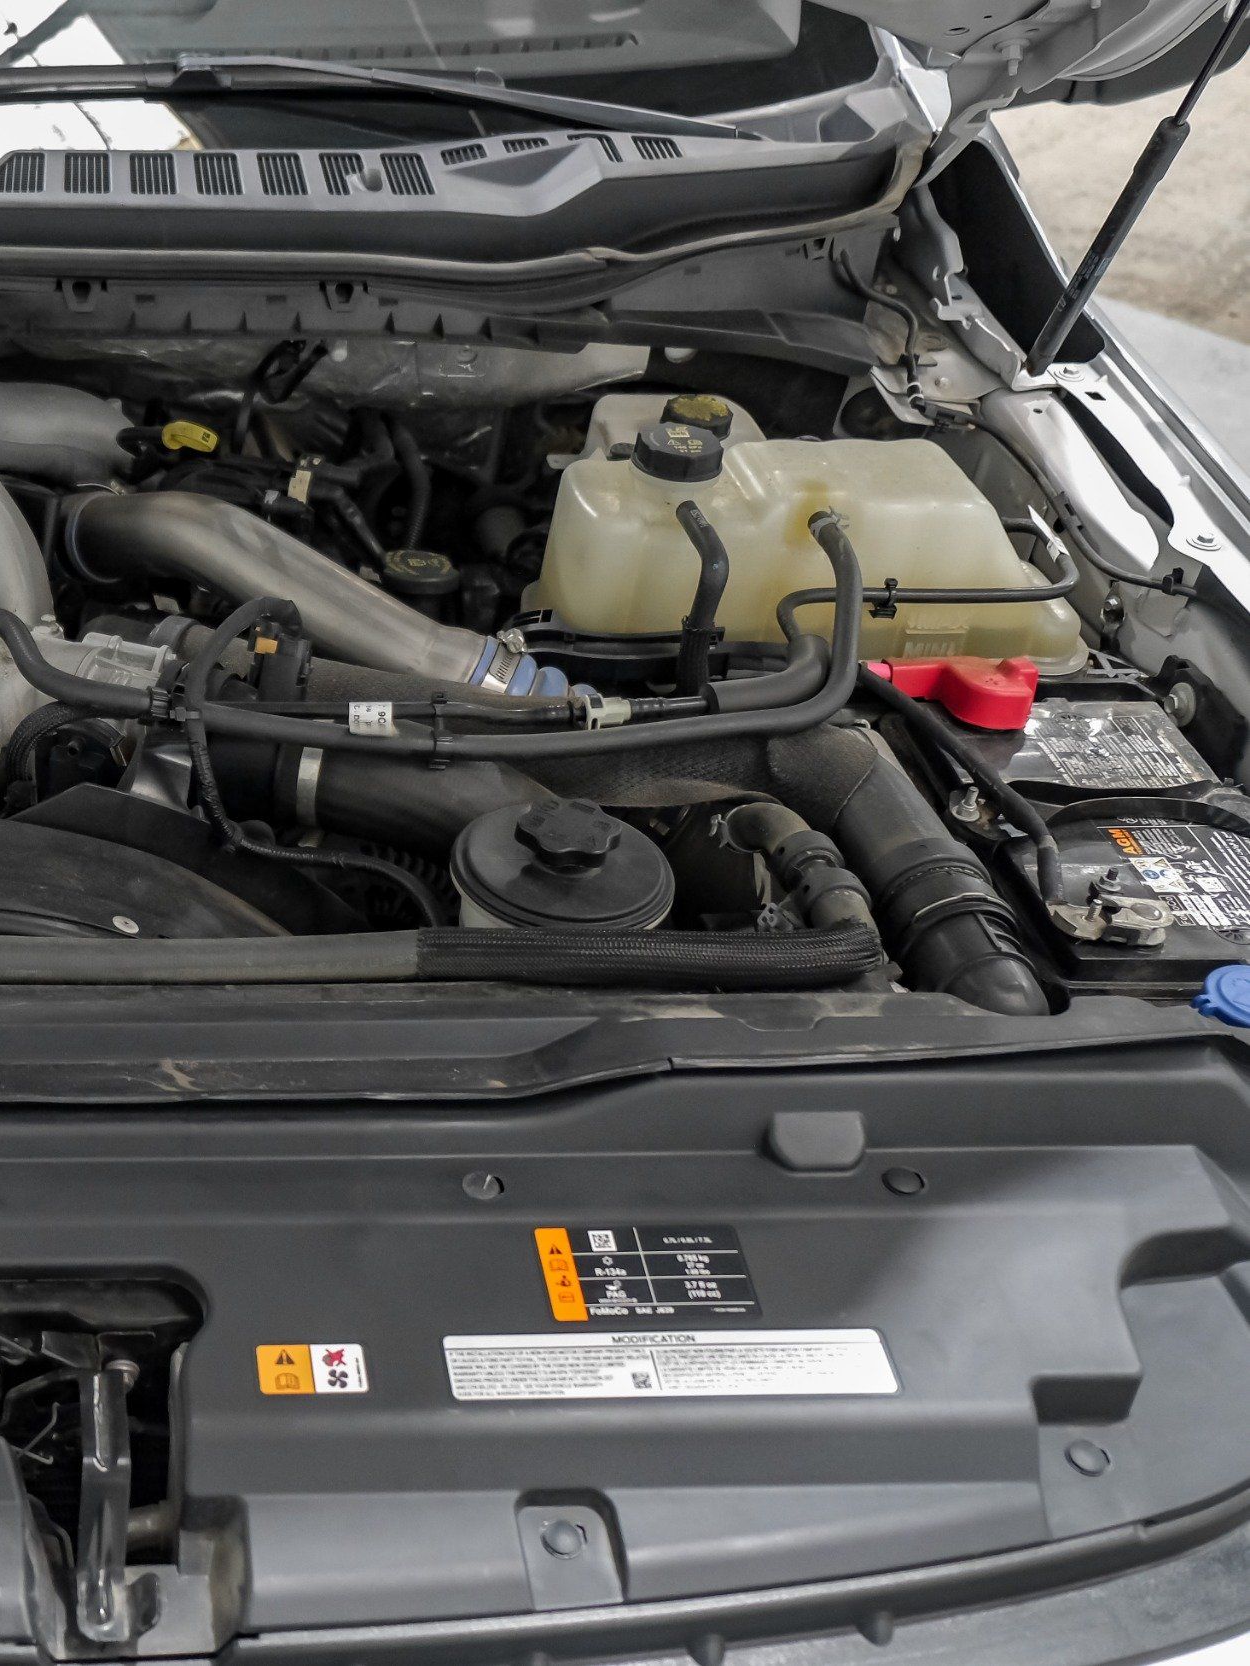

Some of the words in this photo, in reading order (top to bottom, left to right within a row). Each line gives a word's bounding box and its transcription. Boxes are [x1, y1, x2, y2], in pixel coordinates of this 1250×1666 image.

[1108, 829, 1139, 855] AGM
[594, 1267, 627, 1277] R-134a
[605, 1290, 627, 1298] PAG
[589, 1306, 629, 1316] FoMoCo
[611, 1334, 696, 1345] MODIFICATION
